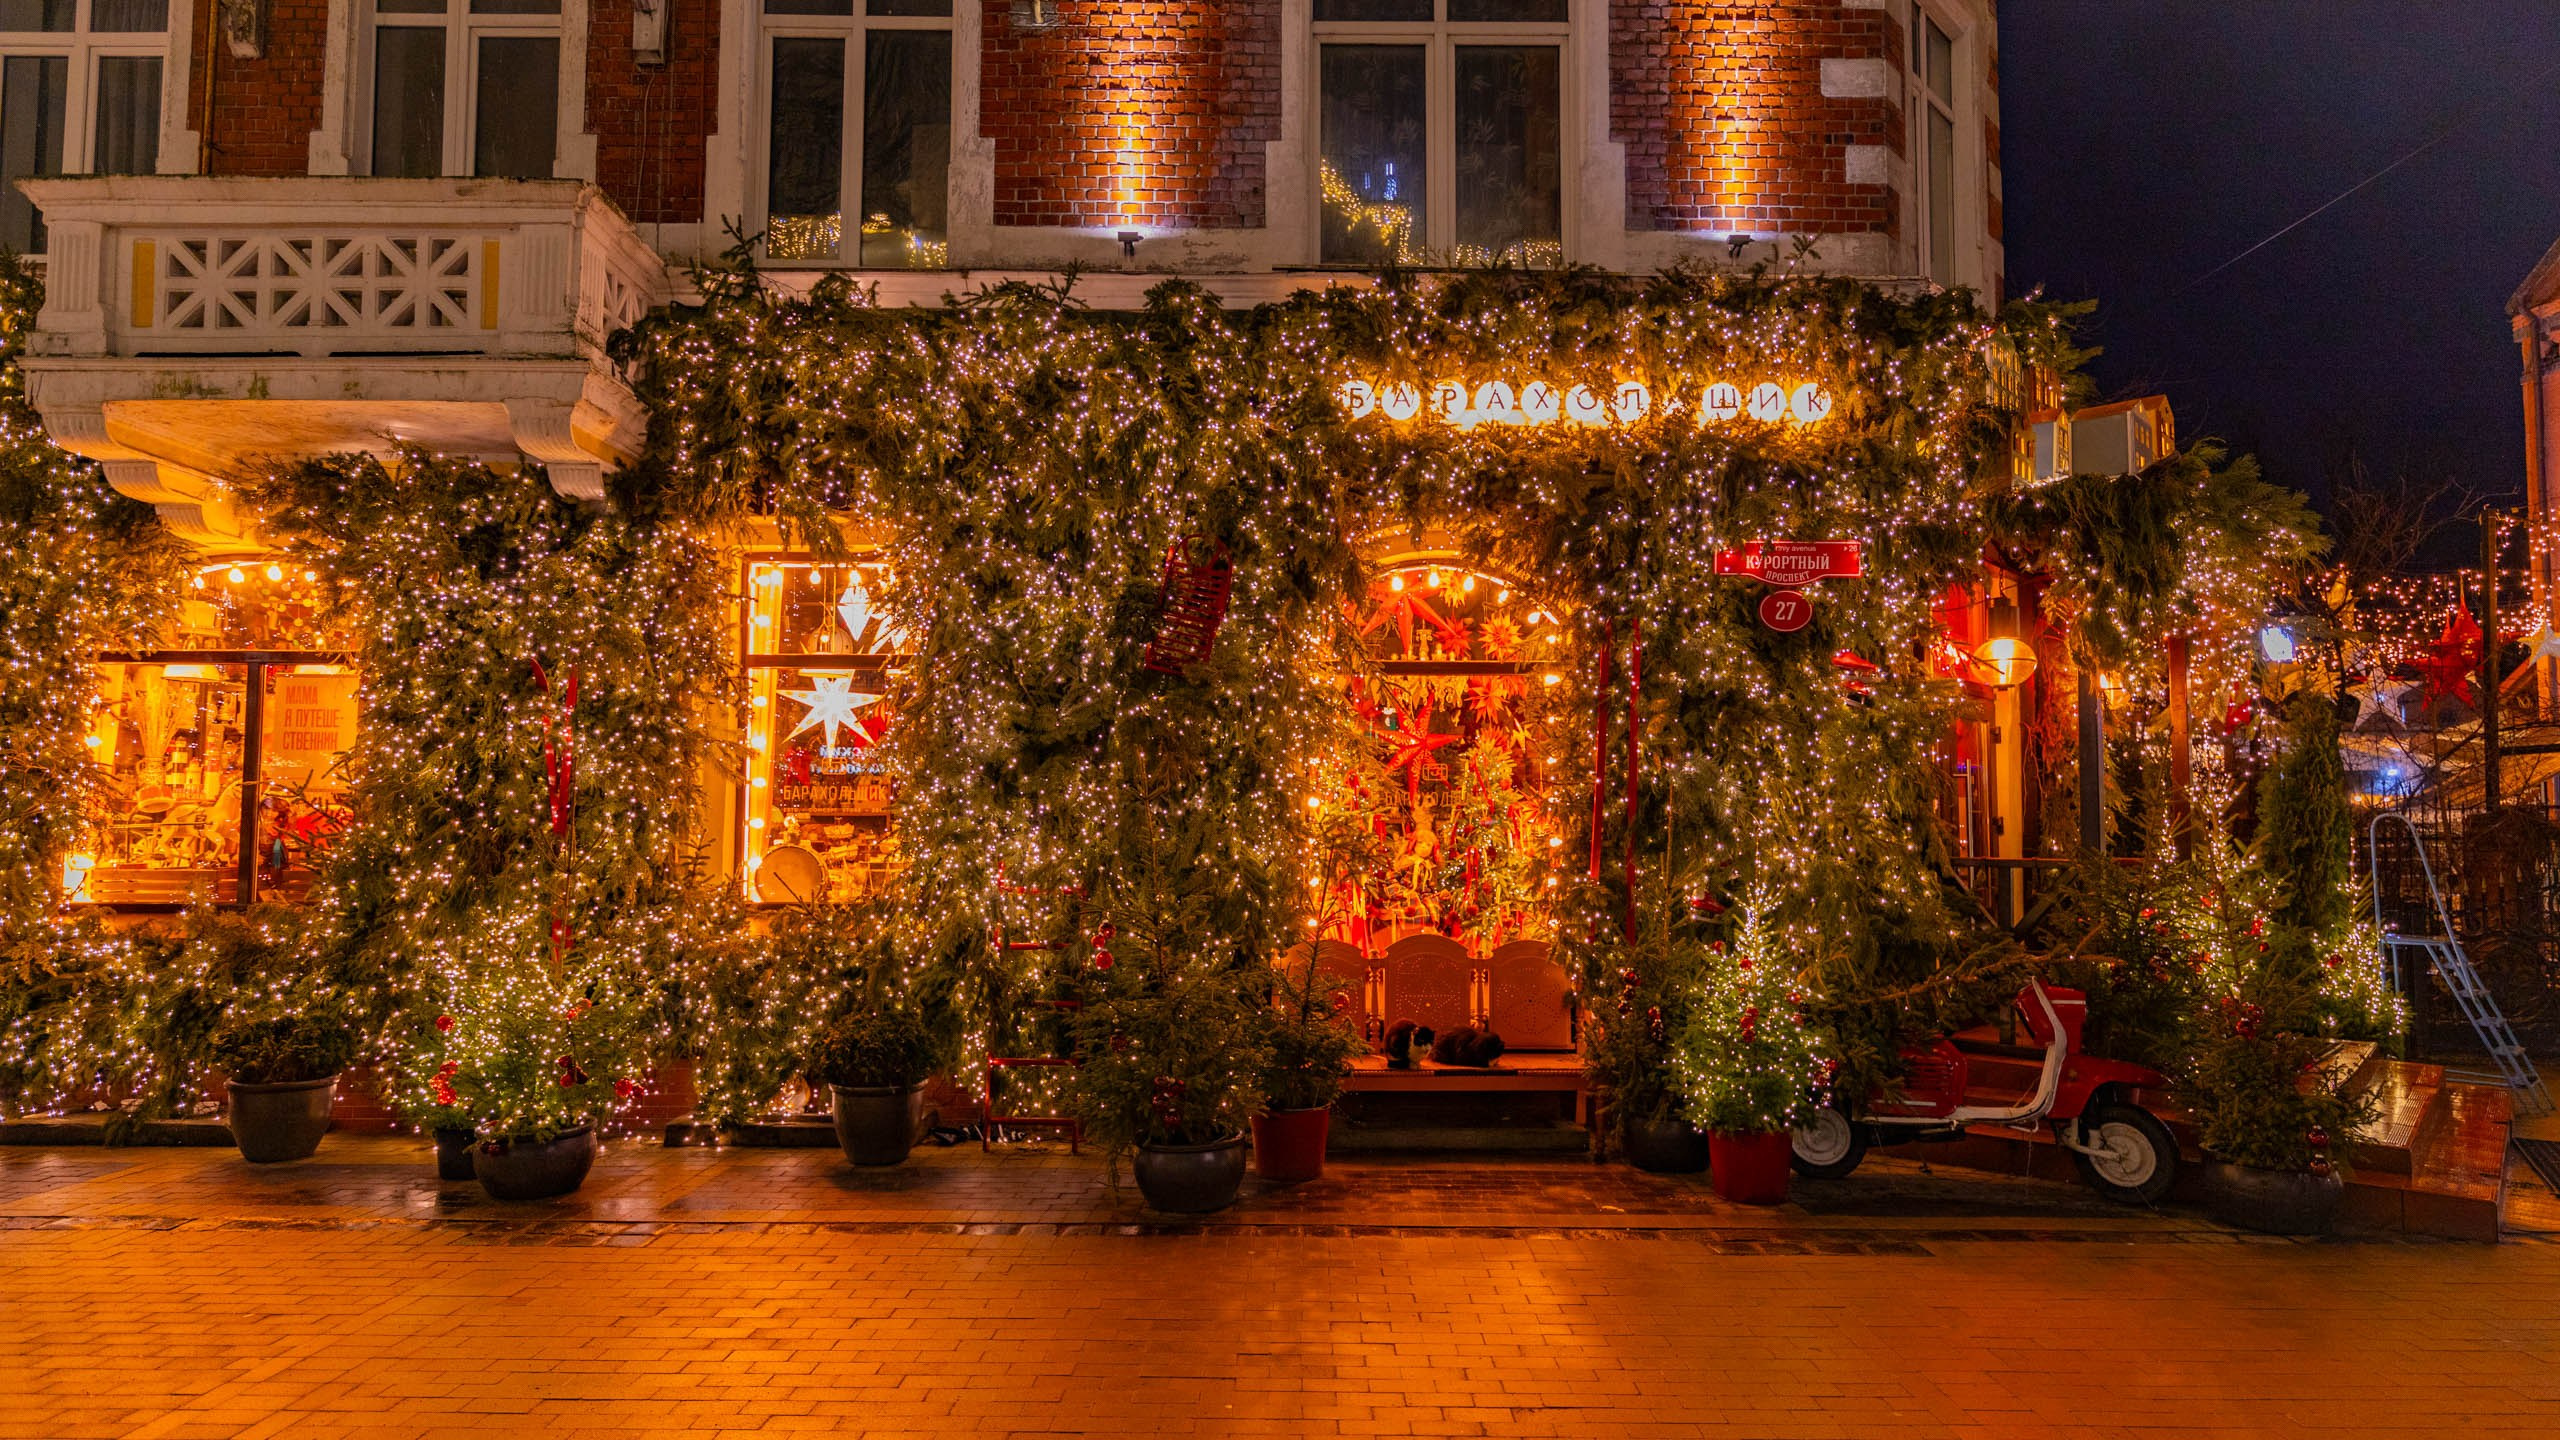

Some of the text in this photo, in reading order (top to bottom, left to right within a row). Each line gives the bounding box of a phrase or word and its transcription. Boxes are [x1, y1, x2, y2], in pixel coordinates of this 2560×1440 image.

[1348, 386, 1825, 416] БАРАХОЛЩИК
[1745, 553, 1830, 570] КУРОРТНЫЙ
[1765, 570, 1811, 582] ПРОСПЕКТ
[1775, 601, 1797, 621] 27
[285, 686, 318, 705] МАМА
[284, 708, 344, 728] Я ПУТЕШЕ-
[282, 731, 339, 751] СТВЕННИК
[783, 785, 887, 801] БАРАХОЛЬЩИК
